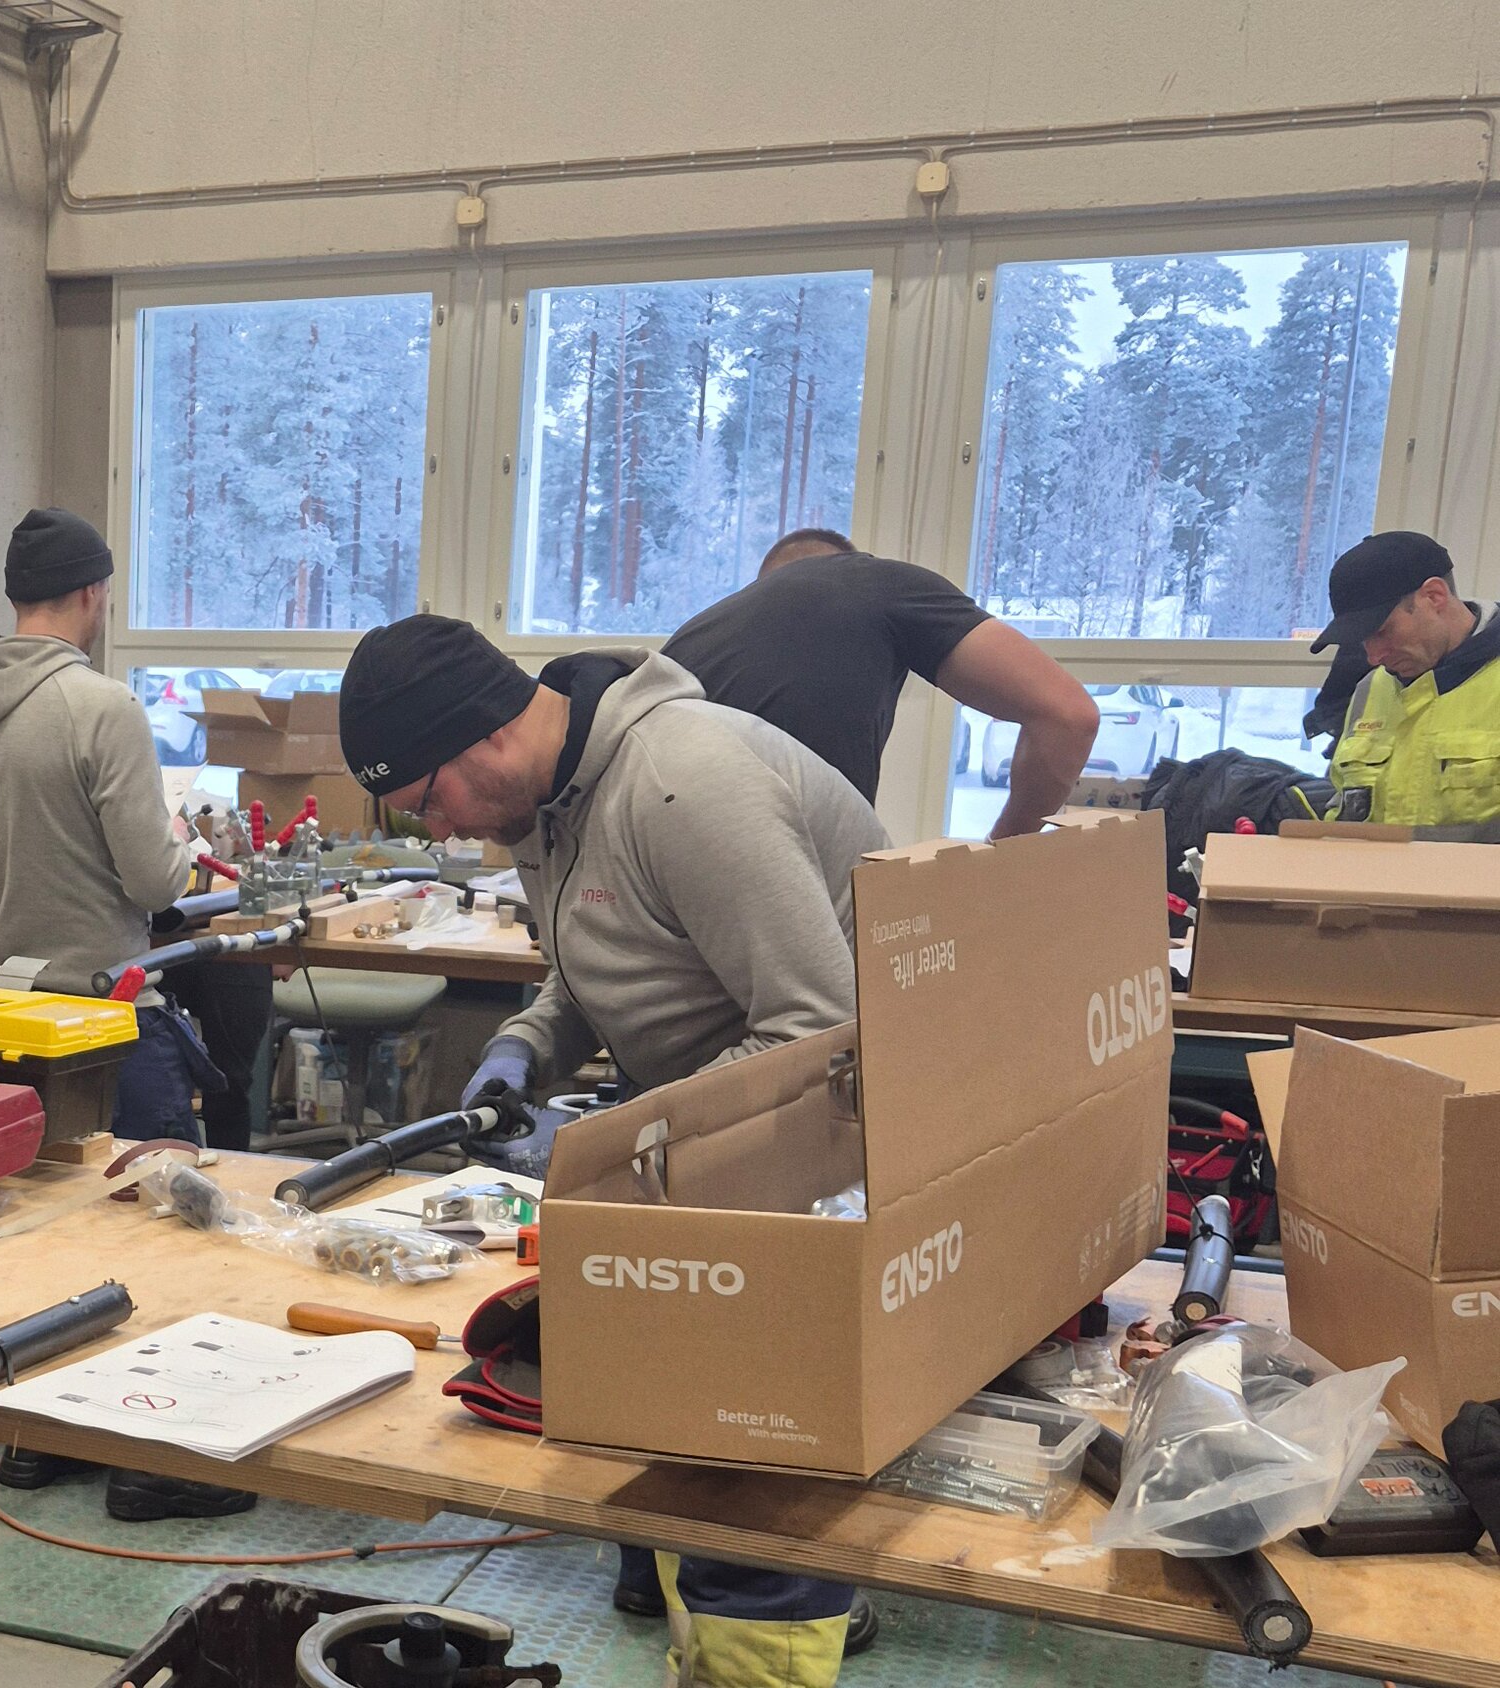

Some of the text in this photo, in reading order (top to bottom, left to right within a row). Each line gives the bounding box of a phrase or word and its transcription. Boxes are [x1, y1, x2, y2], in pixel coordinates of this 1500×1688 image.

[917, 938, 956, 975] Better
[1087, 966, 1166, 1066] ENSTO
[581, 1254, 745, 1296] ENSTO
[881, 1220, 963, 1313] ENSTO
[717, 1408, 799, 1430] Better life.
